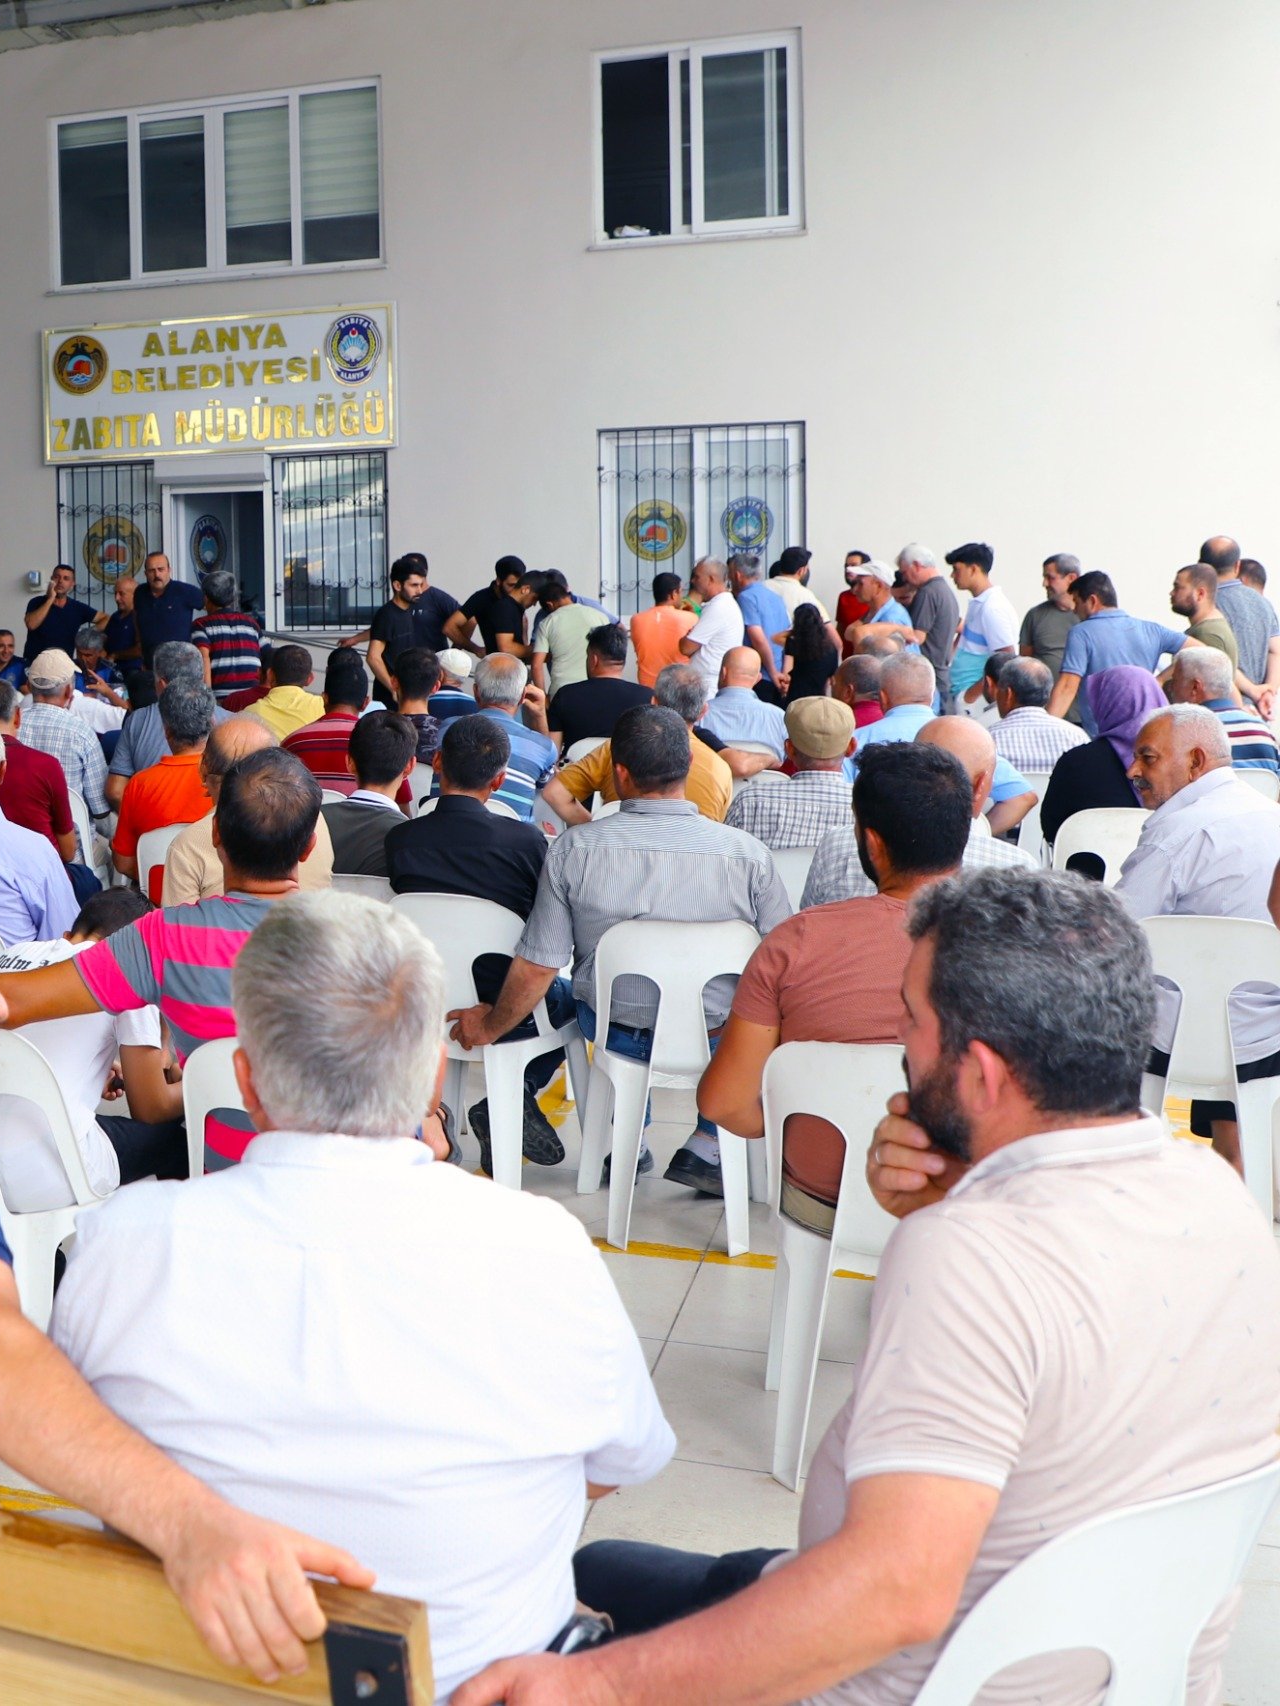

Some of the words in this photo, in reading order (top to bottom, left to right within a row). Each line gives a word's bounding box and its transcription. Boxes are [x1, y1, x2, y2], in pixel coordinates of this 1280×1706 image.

[141, 322, 288, 358] ALANYA
[339, 317, 369, 329] ZABITA
[111, 348, 320, 394] BELEDİYESİ
[340, 371, 365, 380] ALANYA
[52, 411, 161, 451] ZABITA
[174, 390, 385, 445] MÜDÜRLÜĞÜ
